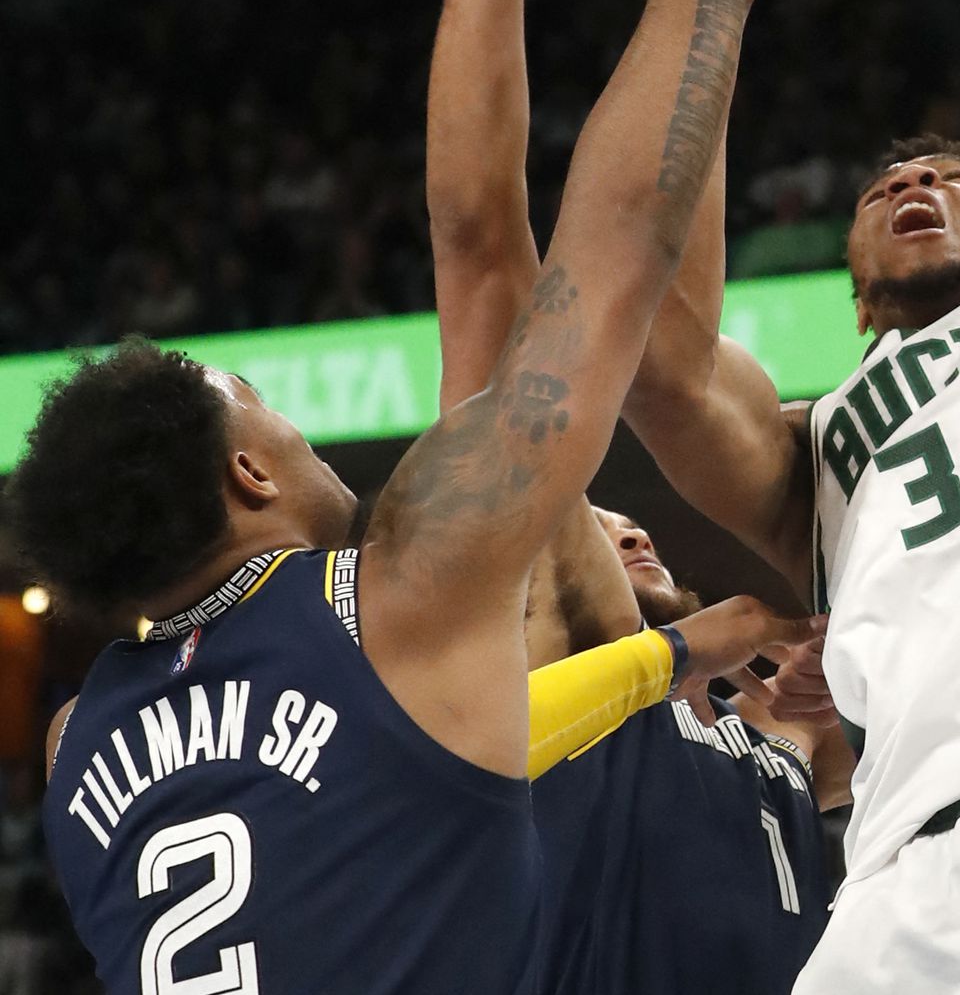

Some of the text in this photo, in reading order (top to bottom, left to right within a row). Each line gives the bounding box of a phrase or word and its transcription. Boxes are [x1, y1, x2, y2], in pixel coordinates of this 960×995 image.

[67, 680, 338, 851] TILLMAN SR.
[137, 812, 260, 995] 2
